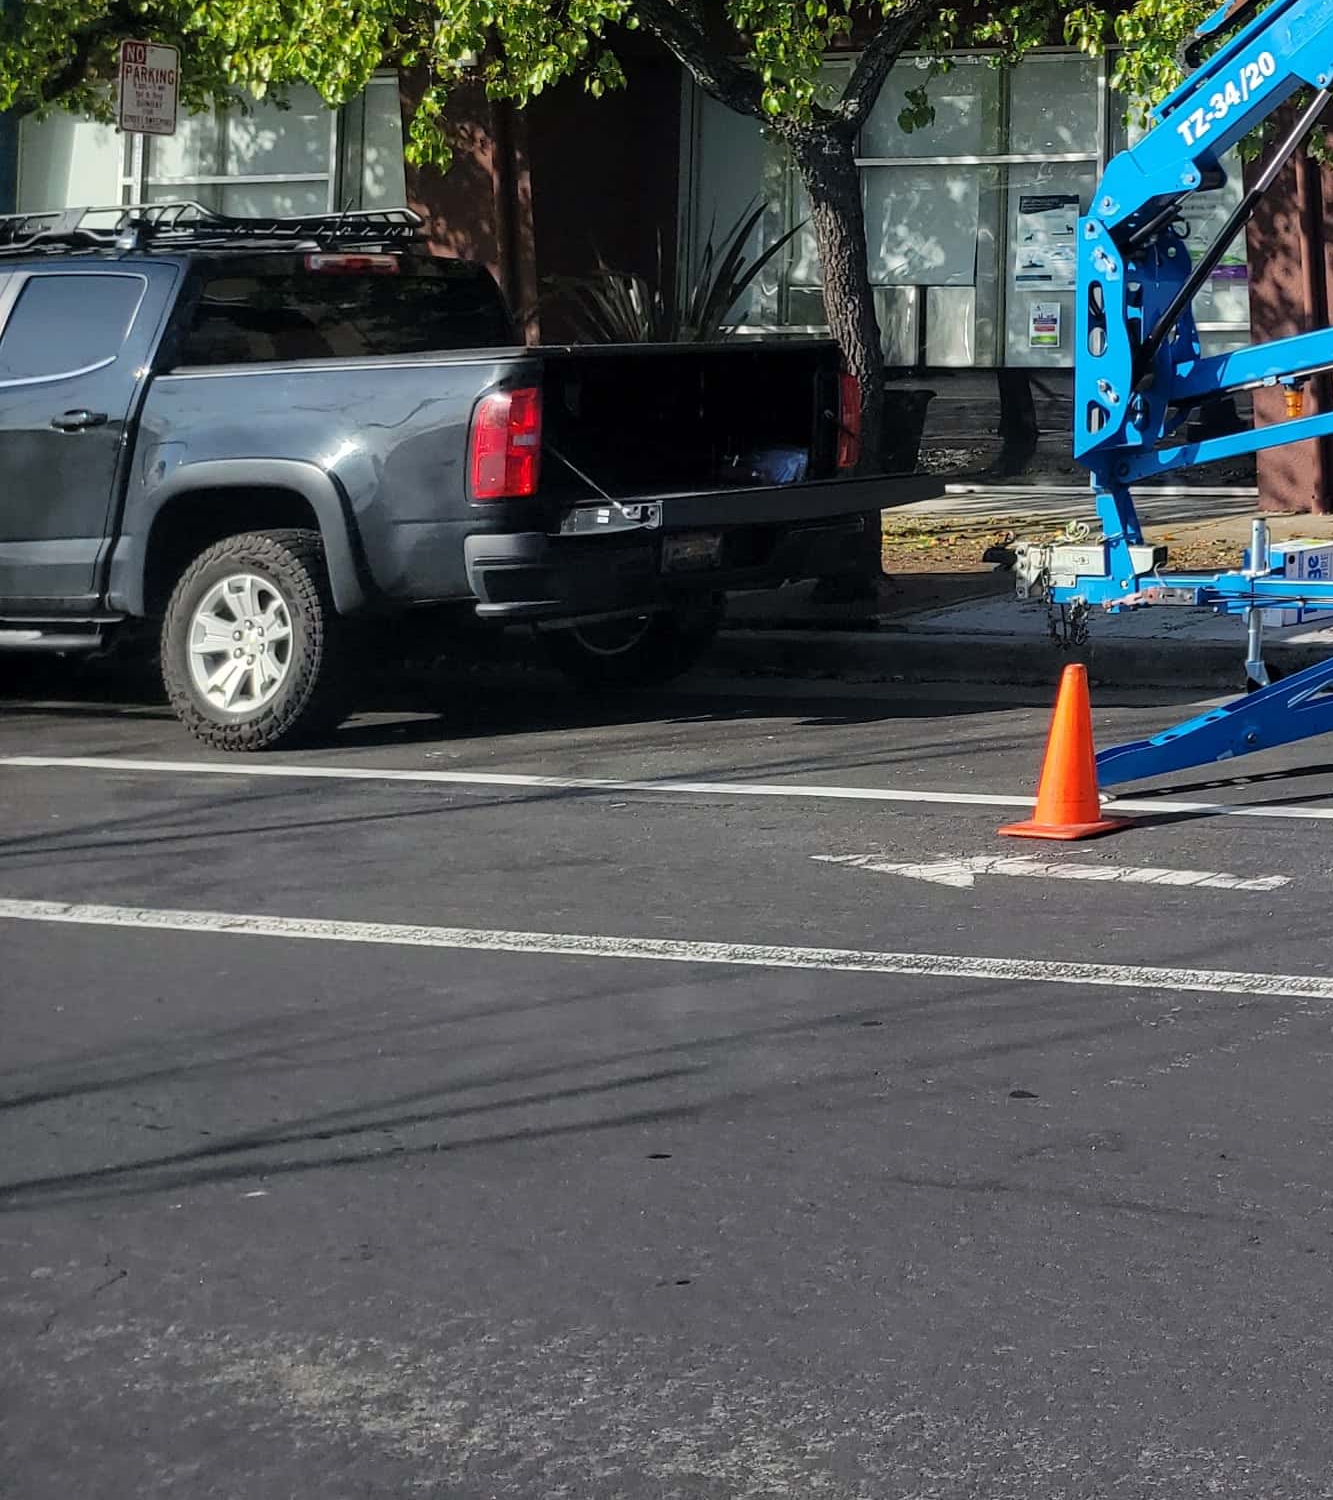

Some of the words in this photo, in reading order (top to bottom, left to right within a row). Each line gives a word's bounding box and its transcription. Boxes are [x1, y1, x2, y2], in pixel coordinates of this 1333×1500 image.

[127, 44, 145, 62] NO
[125, 65, 175, 85] PARKING
[1176, 51, 1276, 146] TZ-34/20
